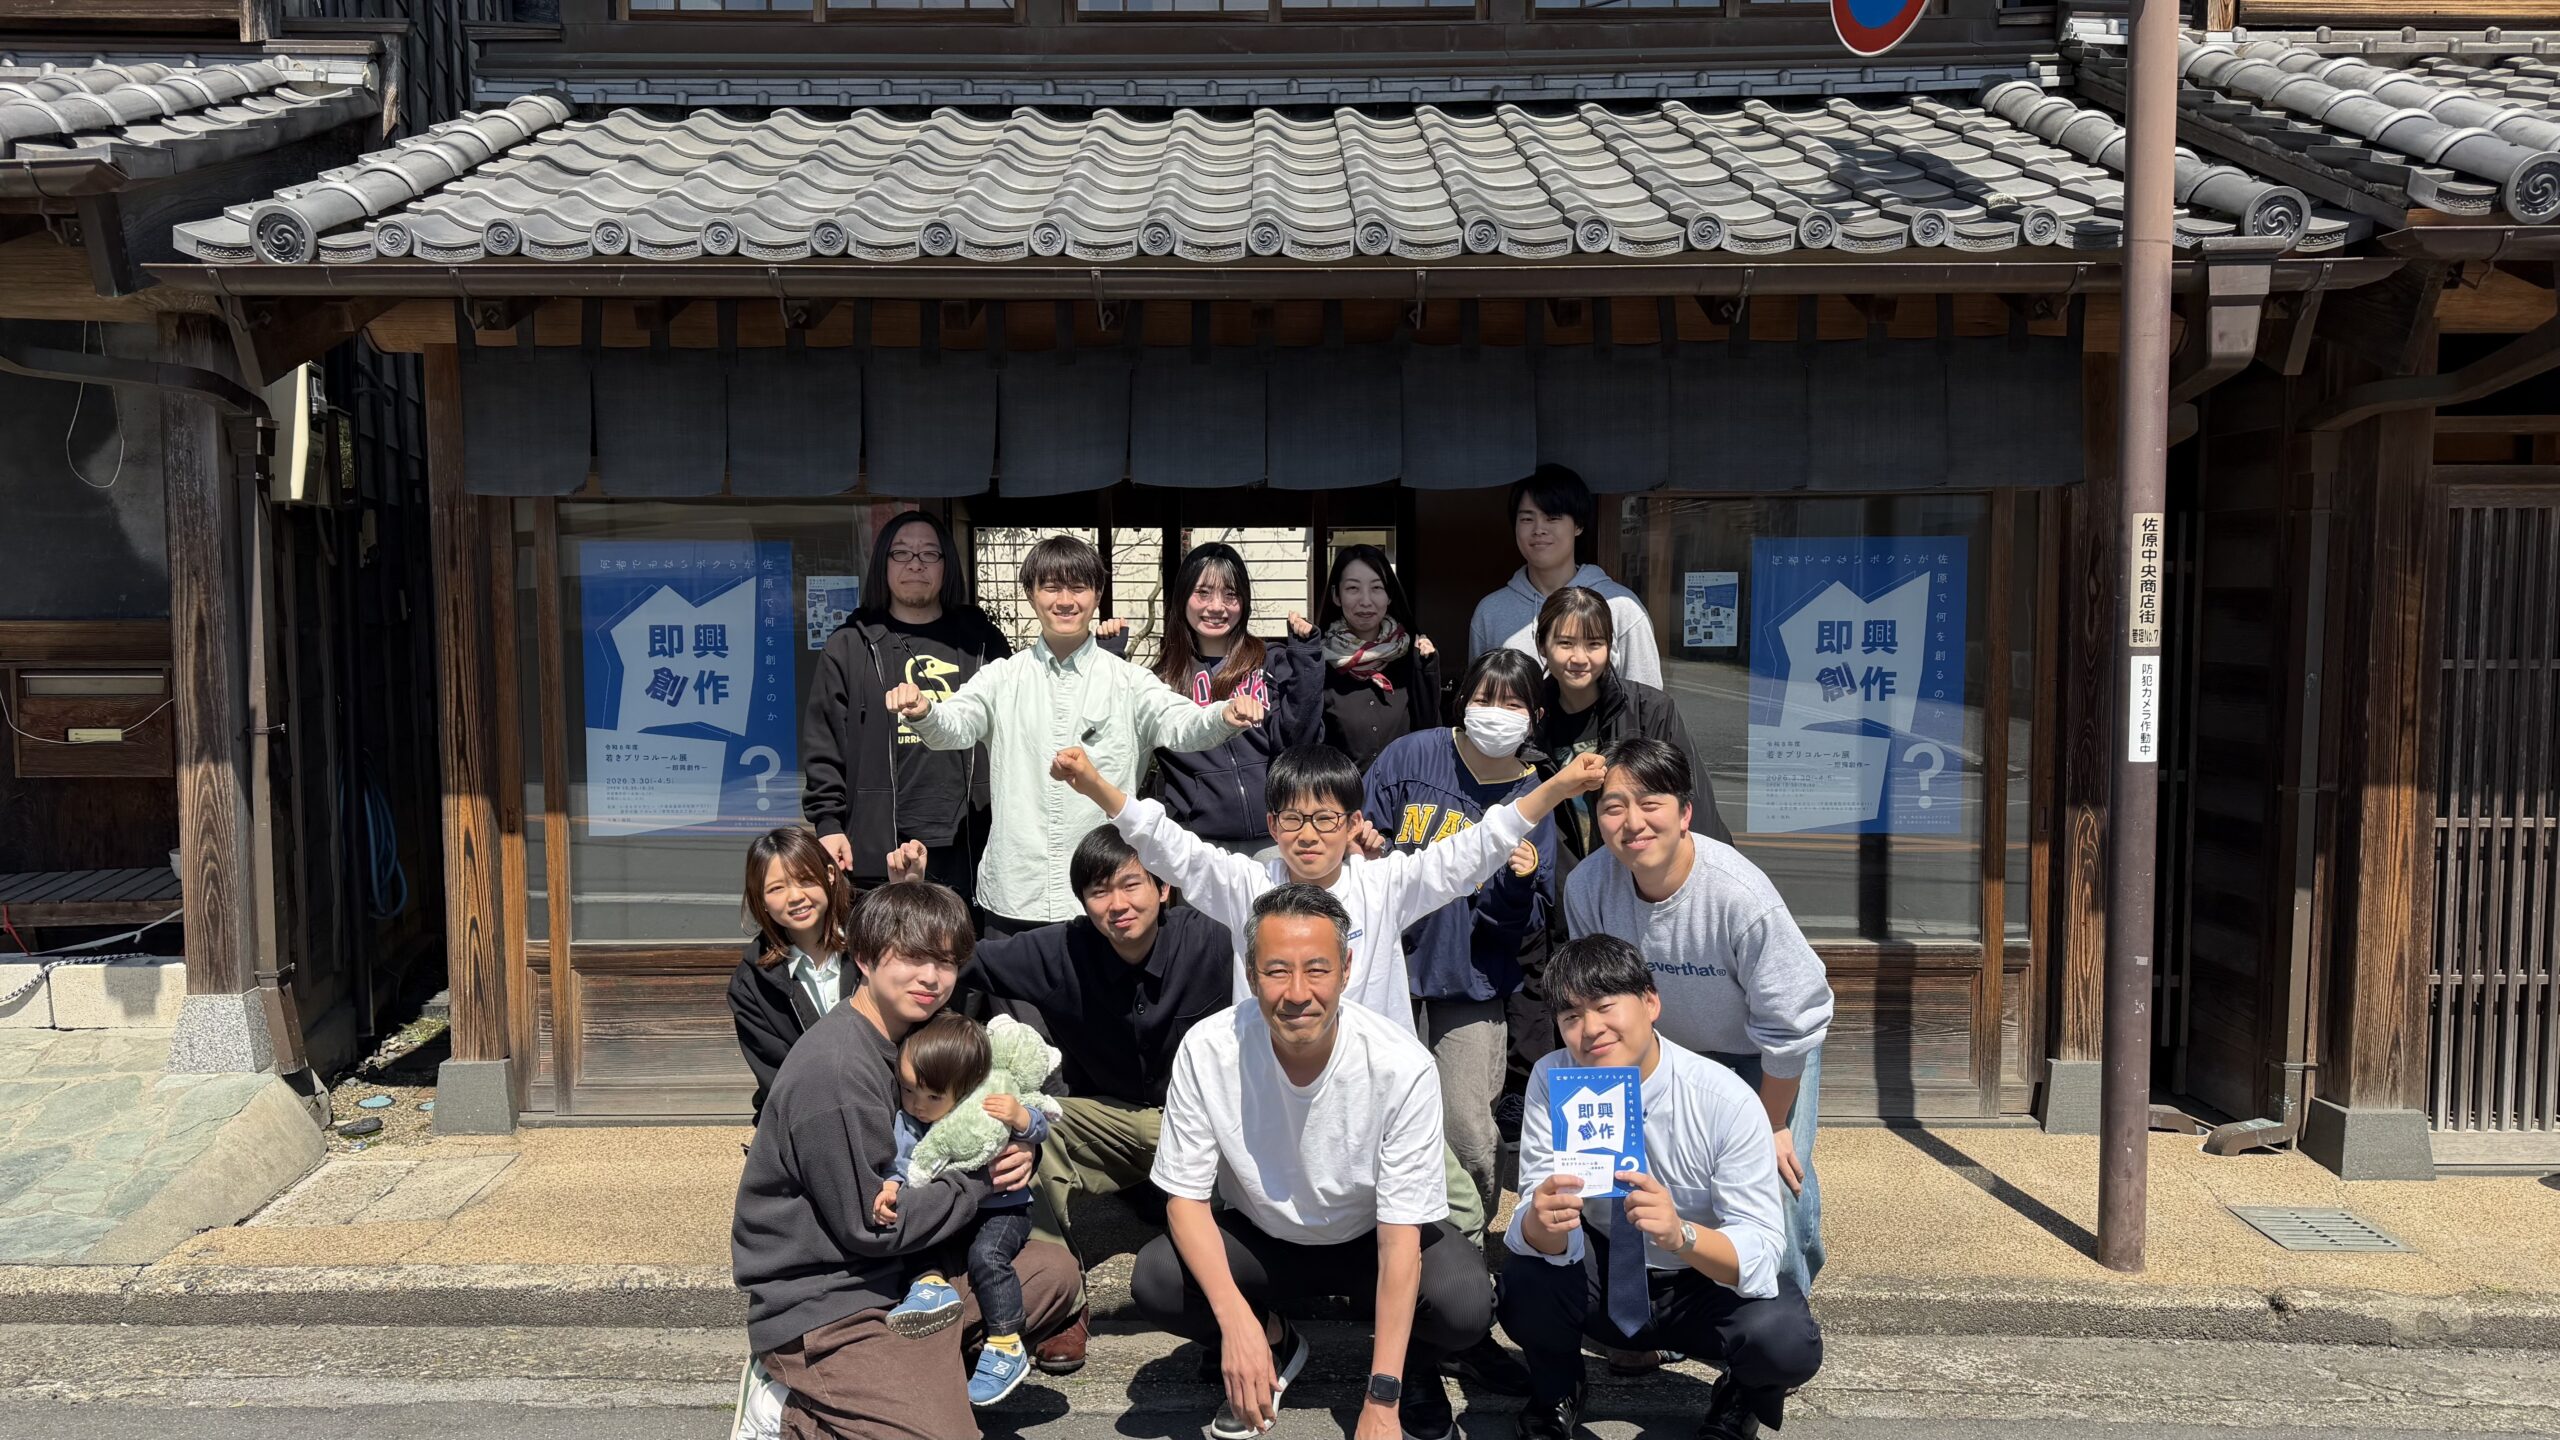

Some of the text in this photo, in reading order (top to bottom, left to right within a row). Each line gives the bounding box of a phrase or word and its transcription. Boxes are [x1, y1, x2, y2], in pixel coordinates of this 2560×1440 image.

[2138, 517, 2158, 624] 佐原中央商店街
[647, 622, 730, 659] 即興
[762, 558, 779, 722] 佐原で何を創るのか
[1815, 618, 1899, 655] 即興
[1933, 553, 1949, 719] 佐原で何を創るのか
[645, 666, 730, 708] 創作
[1815, 661, 1898, 704] 創作
[2139, 663, 2153, 756] 防犯カメラ作動中
[739, 745, 782, 811] ?
[1902, 743, 1945, 809] ?
[1395, 803, 1476, 845] NA
